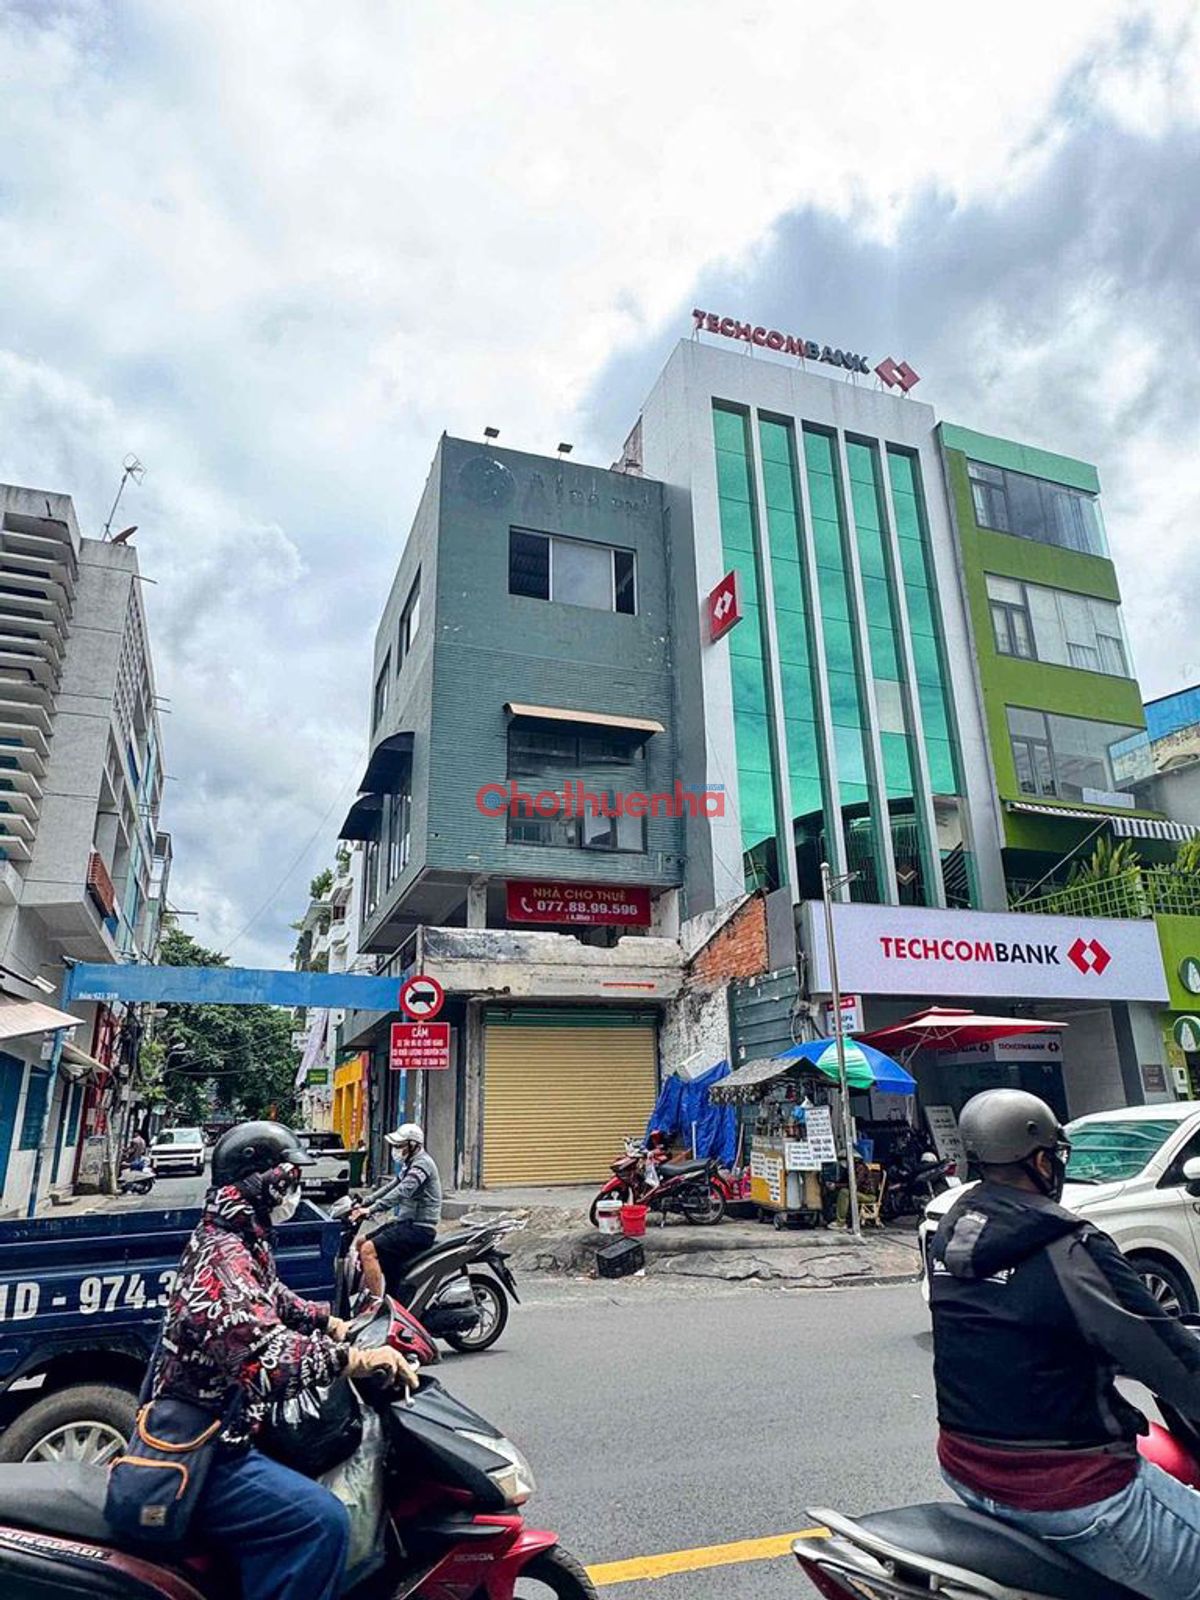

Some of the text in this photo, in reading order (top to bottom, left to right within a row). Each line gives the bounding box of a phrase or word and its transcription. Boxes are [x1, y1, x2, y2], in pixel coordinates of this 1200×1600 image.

[692, 308, 870, 375] TECHCOMBANK
[532, 886, 626, 901] NHÀ CHO THUÊ
[537, 900, 638, 915] 077.88.99.596
[879, 937, 1061, 965] TECHCOMBANK
